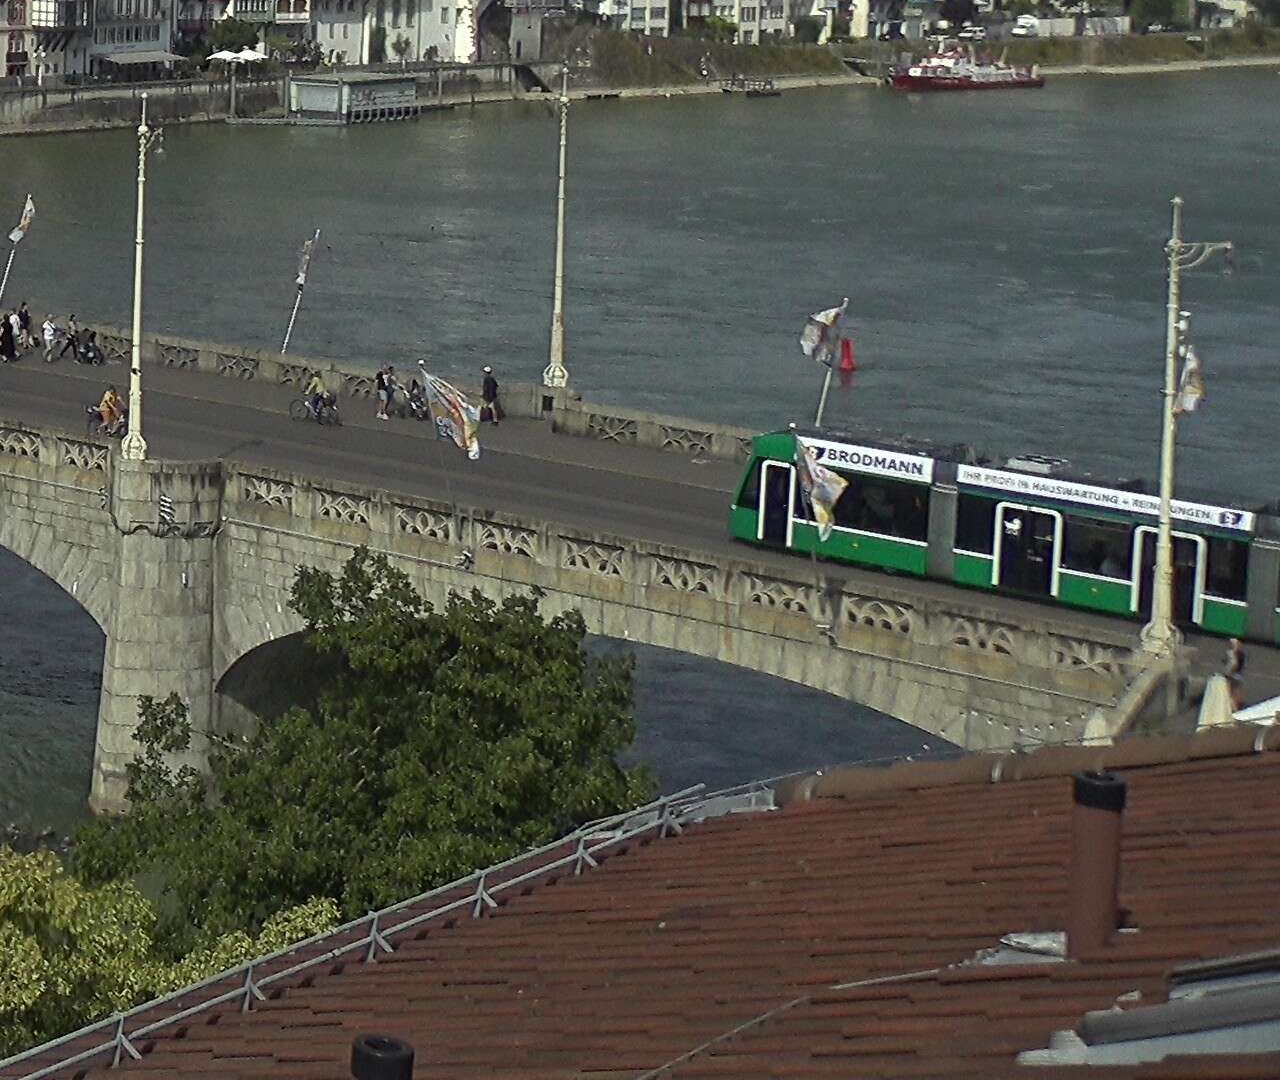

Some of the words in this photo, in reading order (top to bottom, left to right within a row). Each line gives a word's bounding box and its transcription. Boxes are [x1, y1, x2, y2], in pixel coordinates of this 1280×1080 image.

[826, 448, 924, 476] BRODMANN
[962, 470, 981, 481] IHR
[984, 474, 1016, 487] PROFI
[1032, 481, 1119, 506] HAUSWARTUNG
